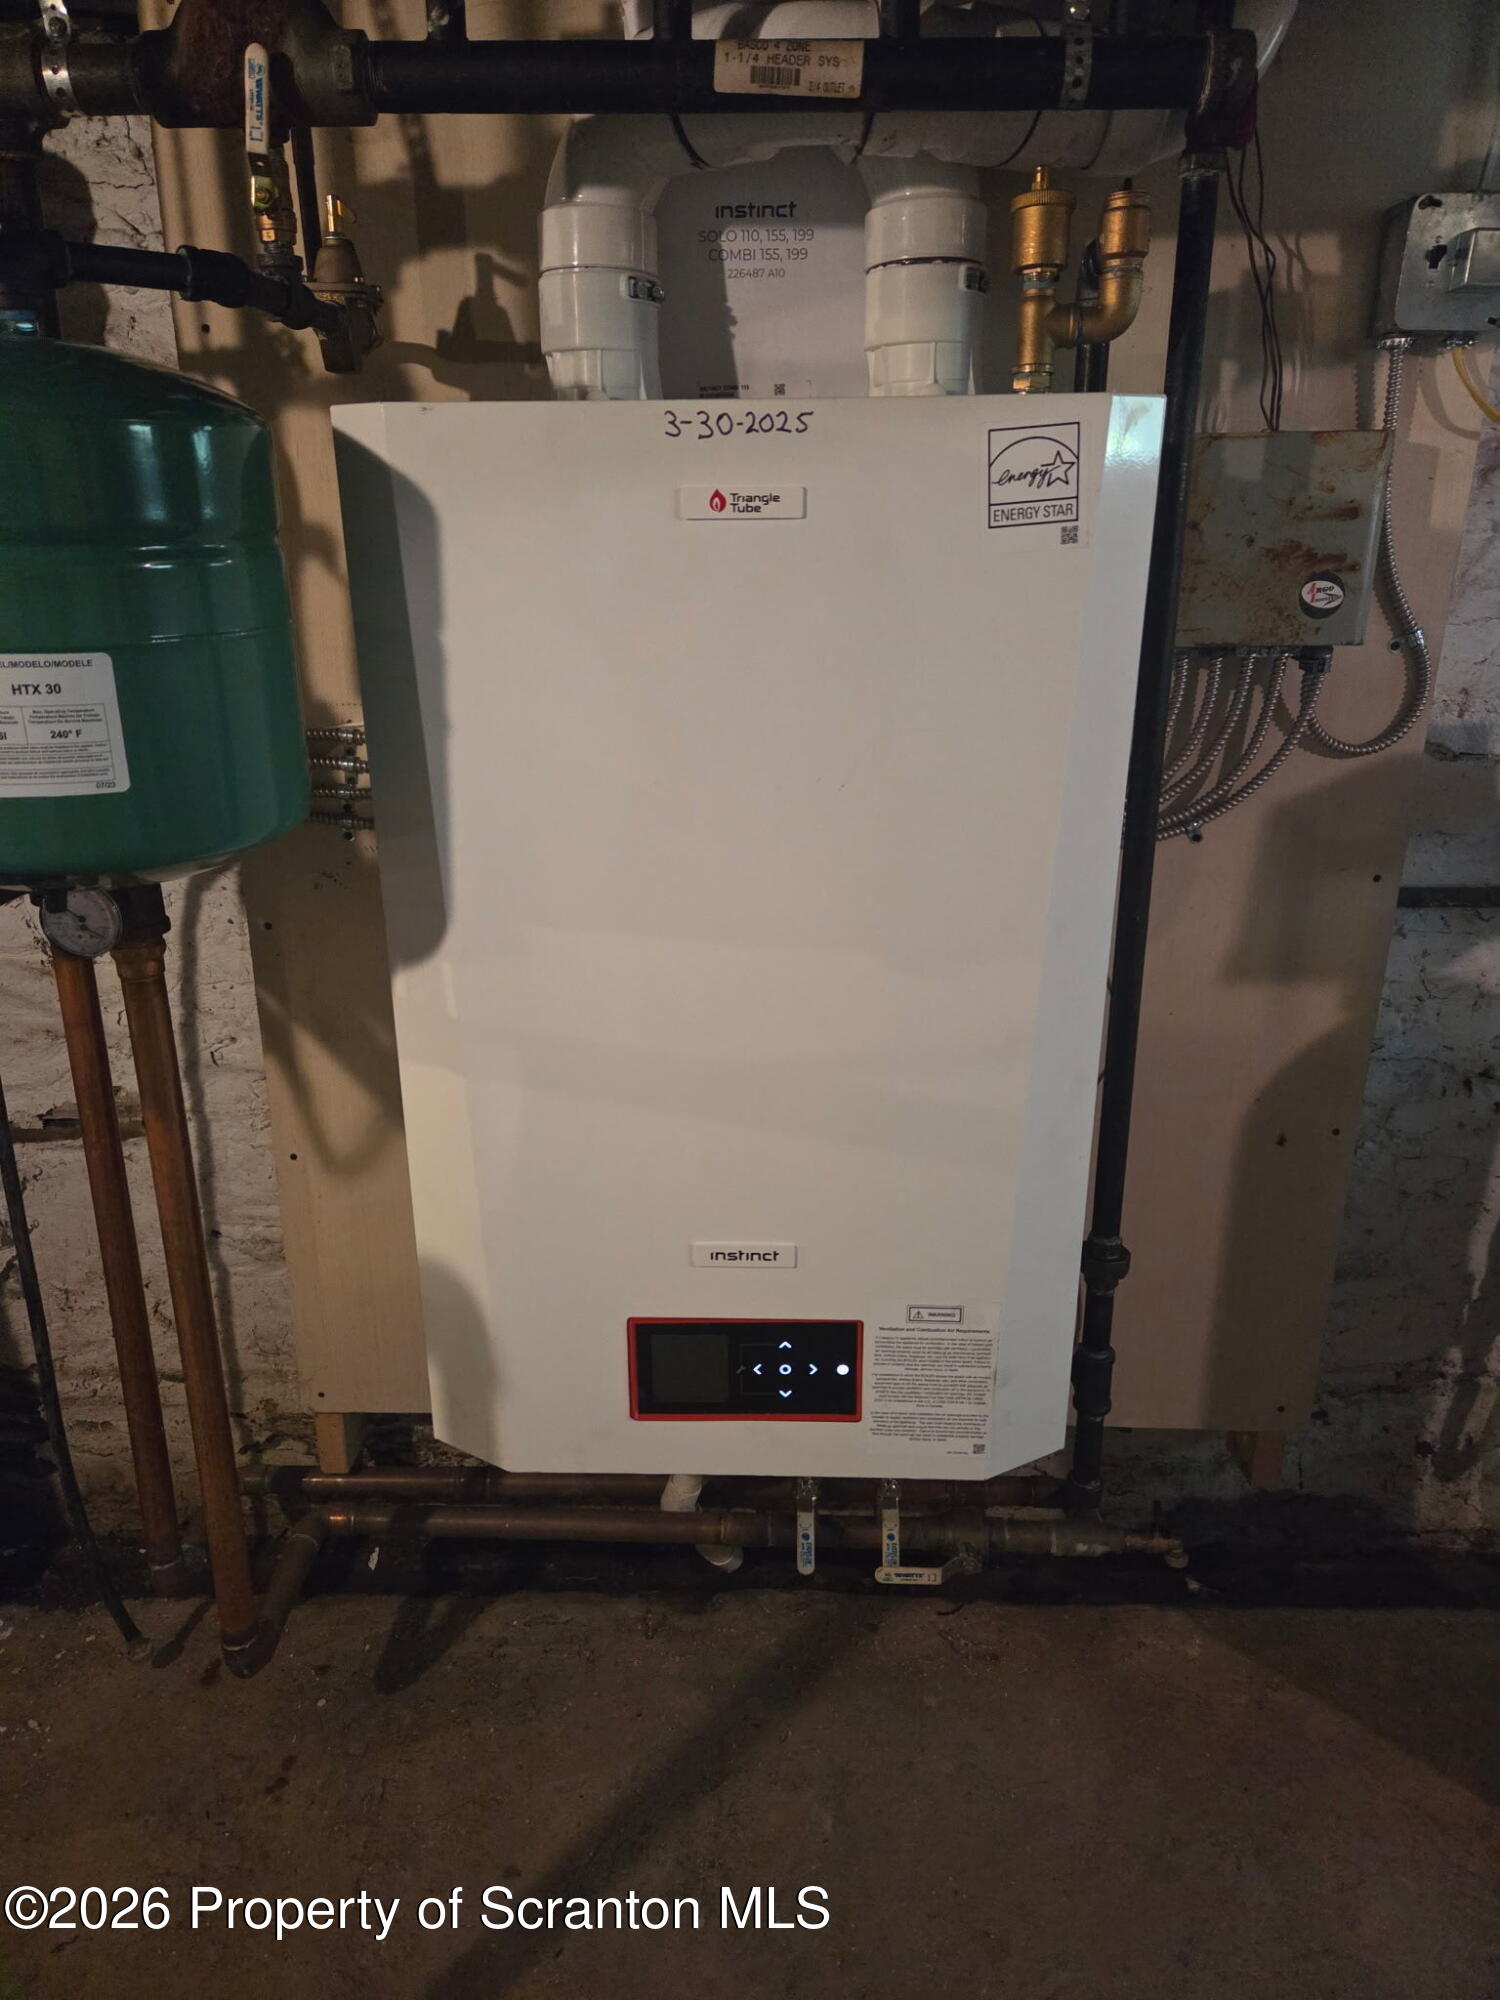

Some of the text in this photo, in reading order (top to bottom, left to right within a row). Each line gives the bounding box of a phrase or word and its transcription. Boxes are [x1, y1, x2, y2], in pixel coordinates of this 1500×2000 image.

[786, 41, 812, 52] ZONE
[724, 52, 841, 67] 1-1/4 HEADER SYS
[715, 201, 797, 219] instinct
[697, 228, 815, 243] SOLO 110, 155, 199
[708, 248, 808, 261] COMBI 155, 199
[728, 268, 786, 279] 226487 A10
[664, 410, 814, 439] 3-30-2025
[729, 492, 781, 505] Triangle
[729, 503, 762, 513] Tube
[993, 503, 1073, 522] ENERGY STAR
[11, 683, 62, 695] HTX 30
[51, 729, 82, 739] 240° F
[710, 1250, 780, 1261] instinct
